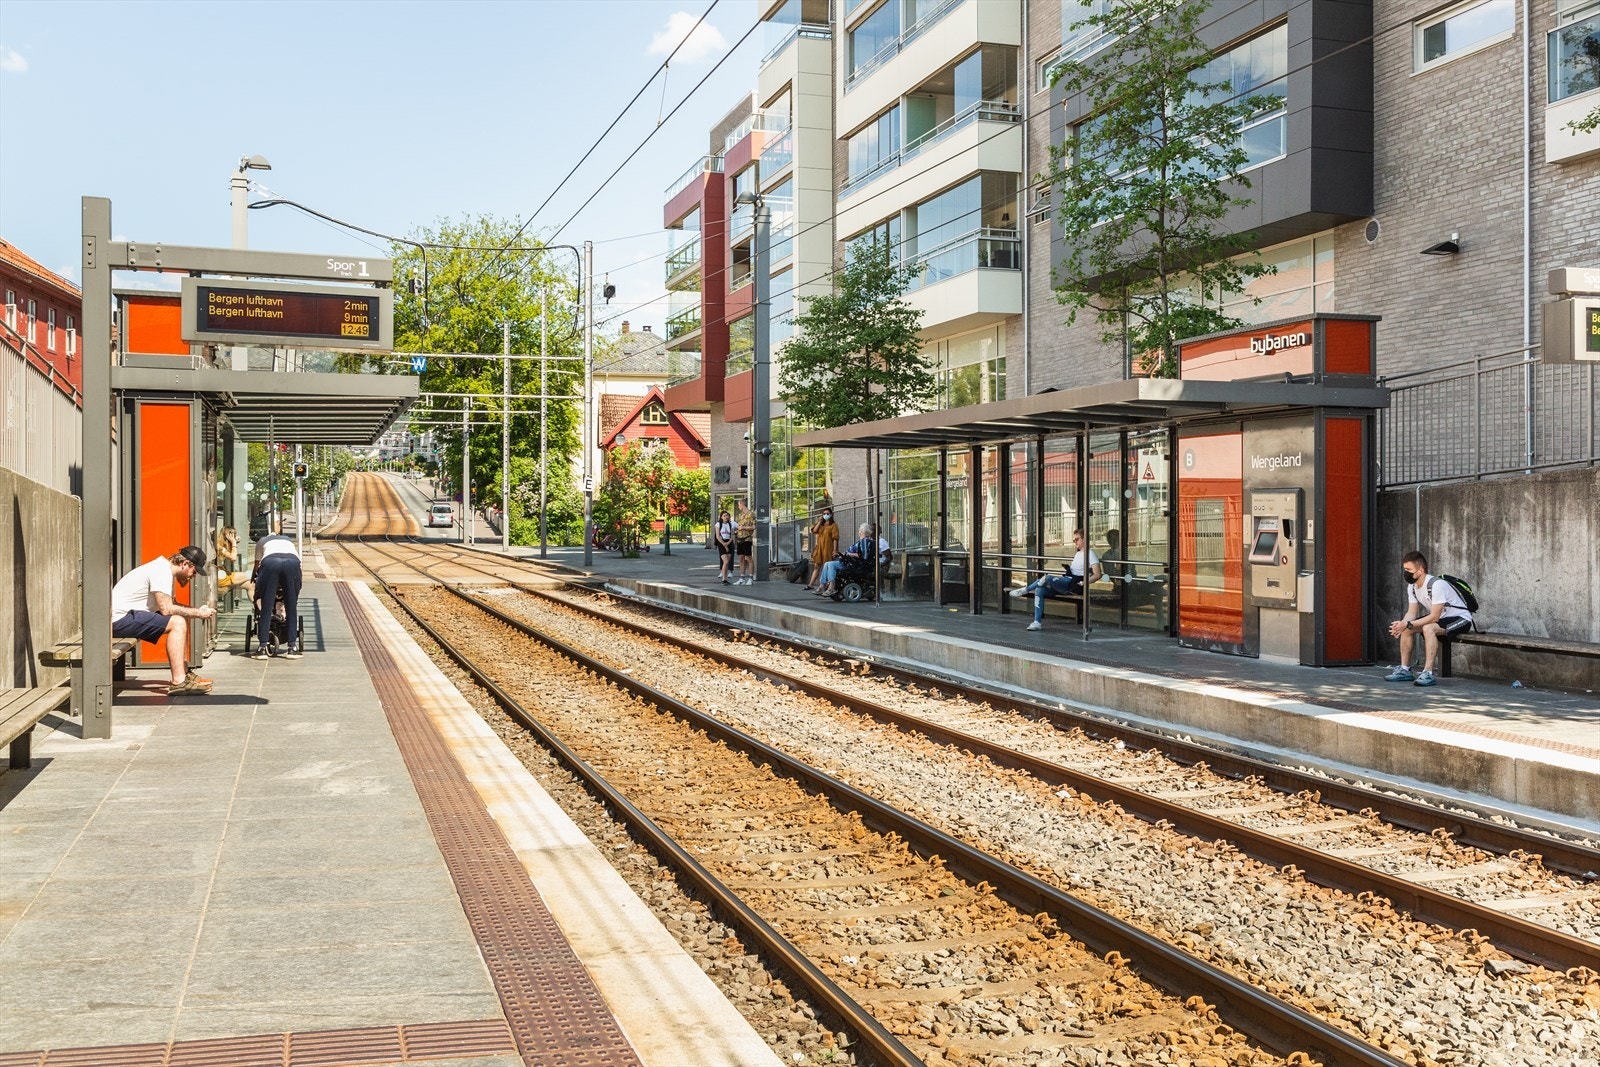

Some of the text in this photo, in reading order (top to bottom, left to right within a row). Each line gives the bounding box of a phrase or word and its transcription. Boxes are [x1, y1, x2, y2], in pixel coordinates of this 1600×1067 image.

[326, 258, 369, 277] Spor 1
[208, 292, 284, 307] Bergen lufthavn
[208, 305, 284, 319] Bergen lufthavn
[342, 324, 368, 335] 12:49
[1250, 332, 1306, 356] bybanen
[412, 357, 426, 370] W
[1186, 453, 1193, 467] B
[1251, 451, 1302, 472] Wergeland
[585, 479, 592, 490] E
